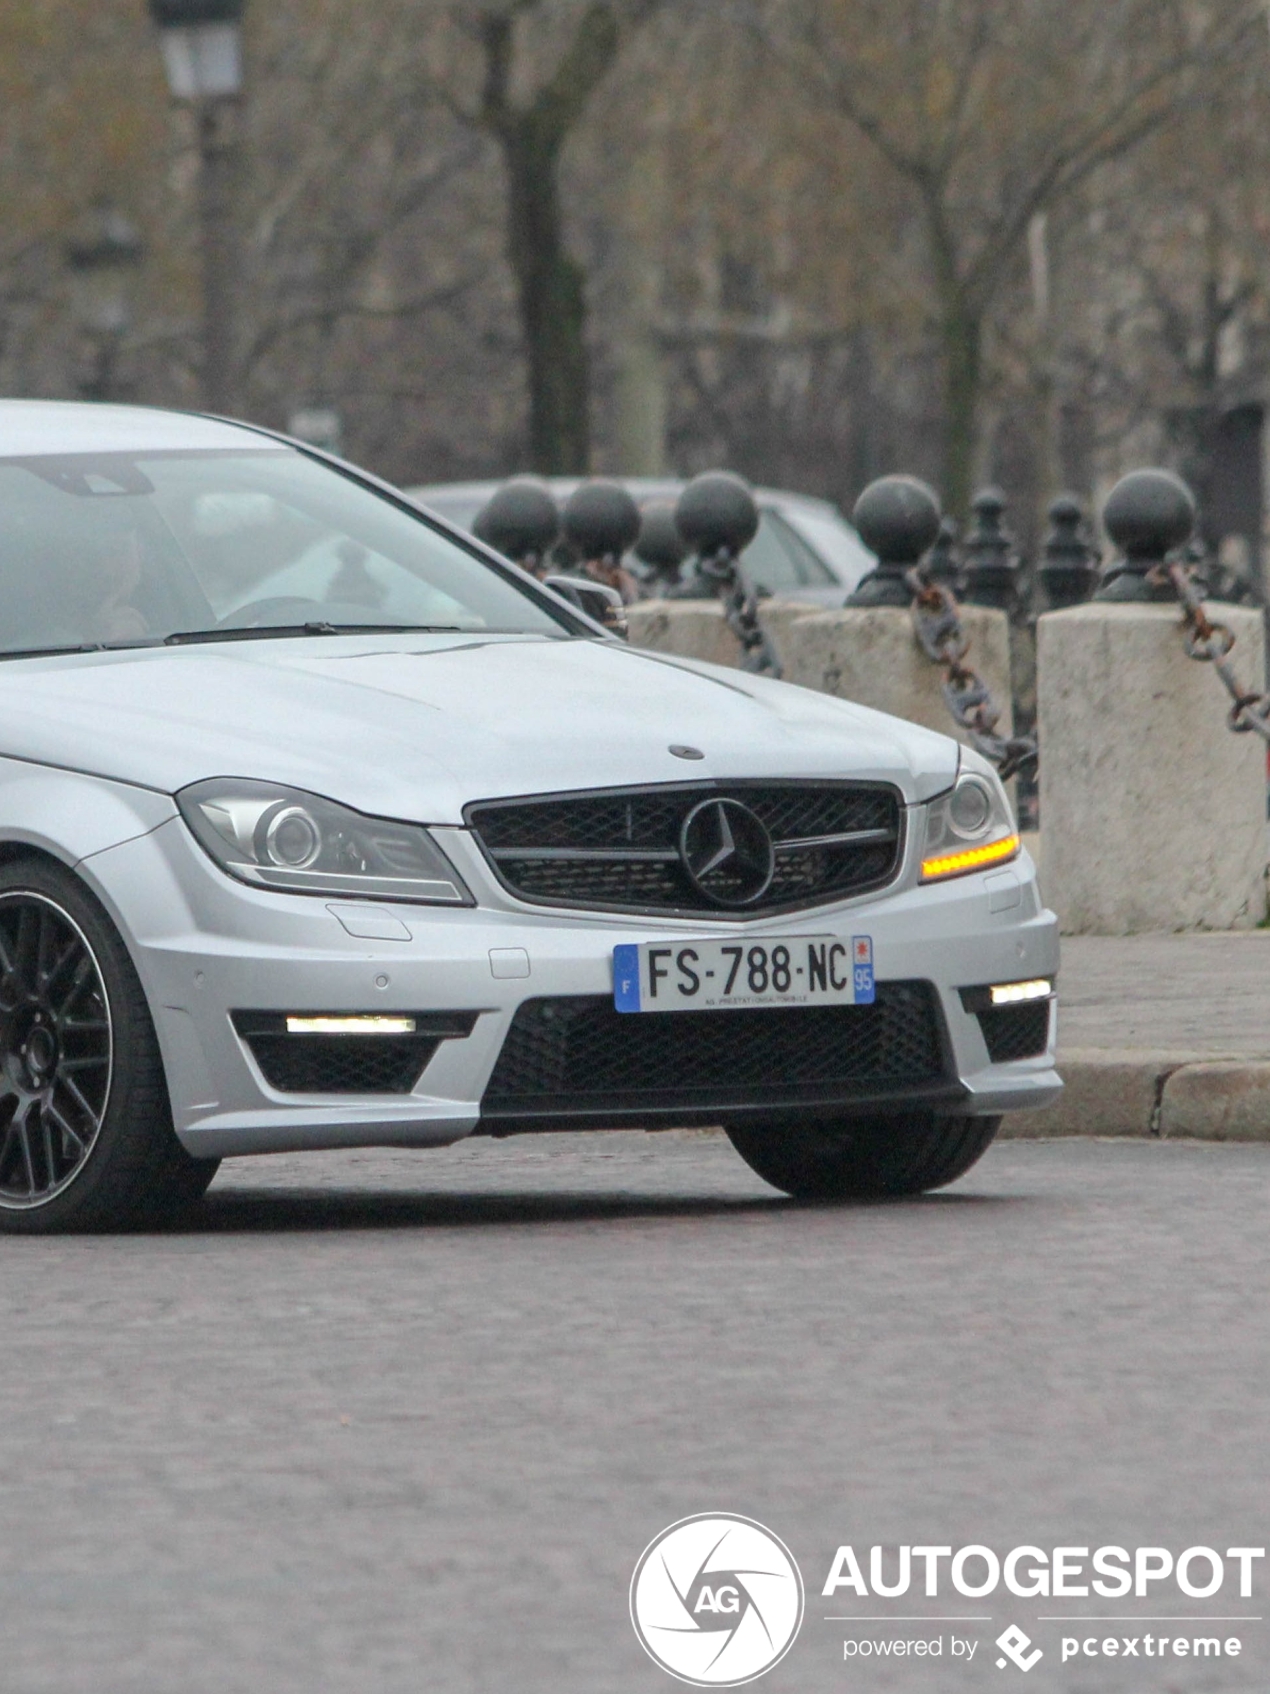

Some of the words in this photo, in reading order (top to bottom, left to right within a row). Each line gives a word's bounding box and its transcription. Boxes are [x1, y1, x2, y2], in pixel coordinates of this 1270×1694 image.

[648, 943, 847, 998] FS-788-NC
[854, 968, 873, 991] 95
[621, 979, 631, 995] F
